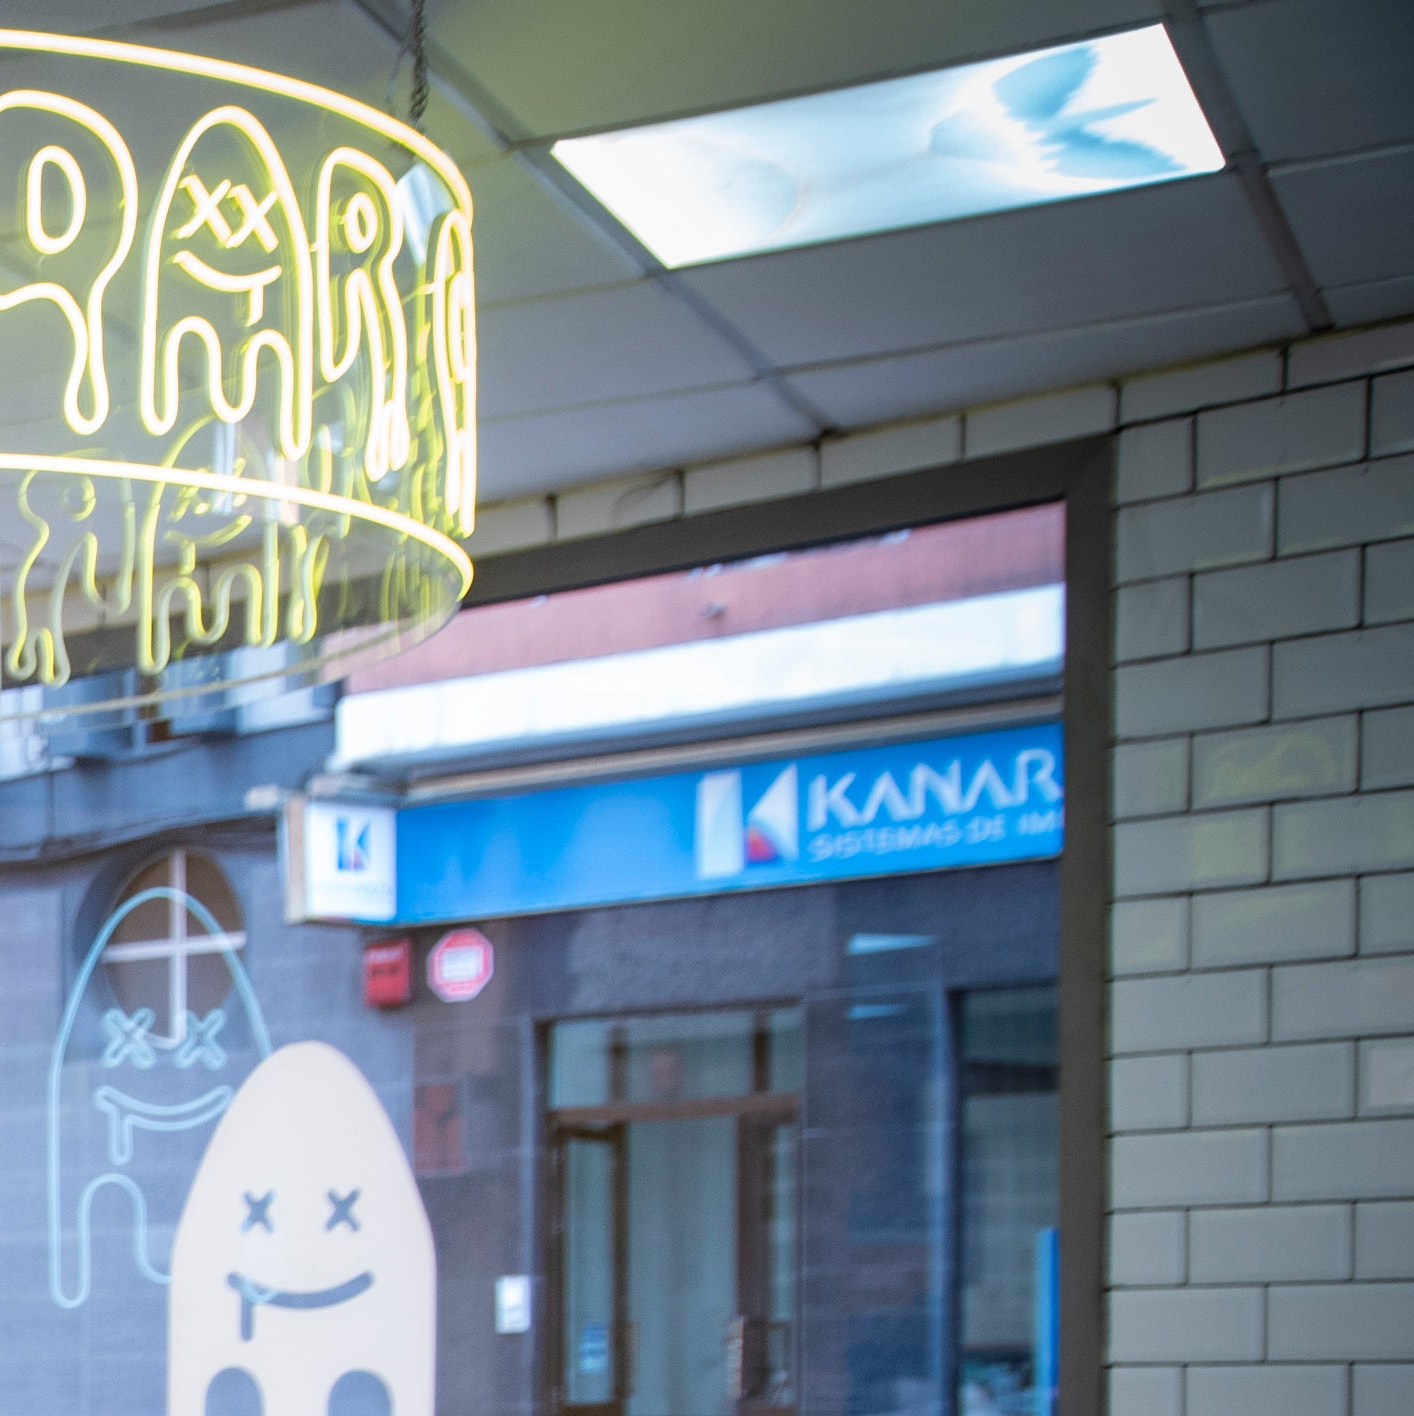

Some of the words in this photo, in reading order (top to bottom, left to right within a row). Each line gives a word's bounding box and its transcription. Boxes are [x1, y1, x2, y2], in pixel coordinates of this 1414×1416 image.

[806, 748, 1063, 832] KANAR
[807, 819, 964, 863] SISTEMAS
[965, 813, 1007, 845] DE
